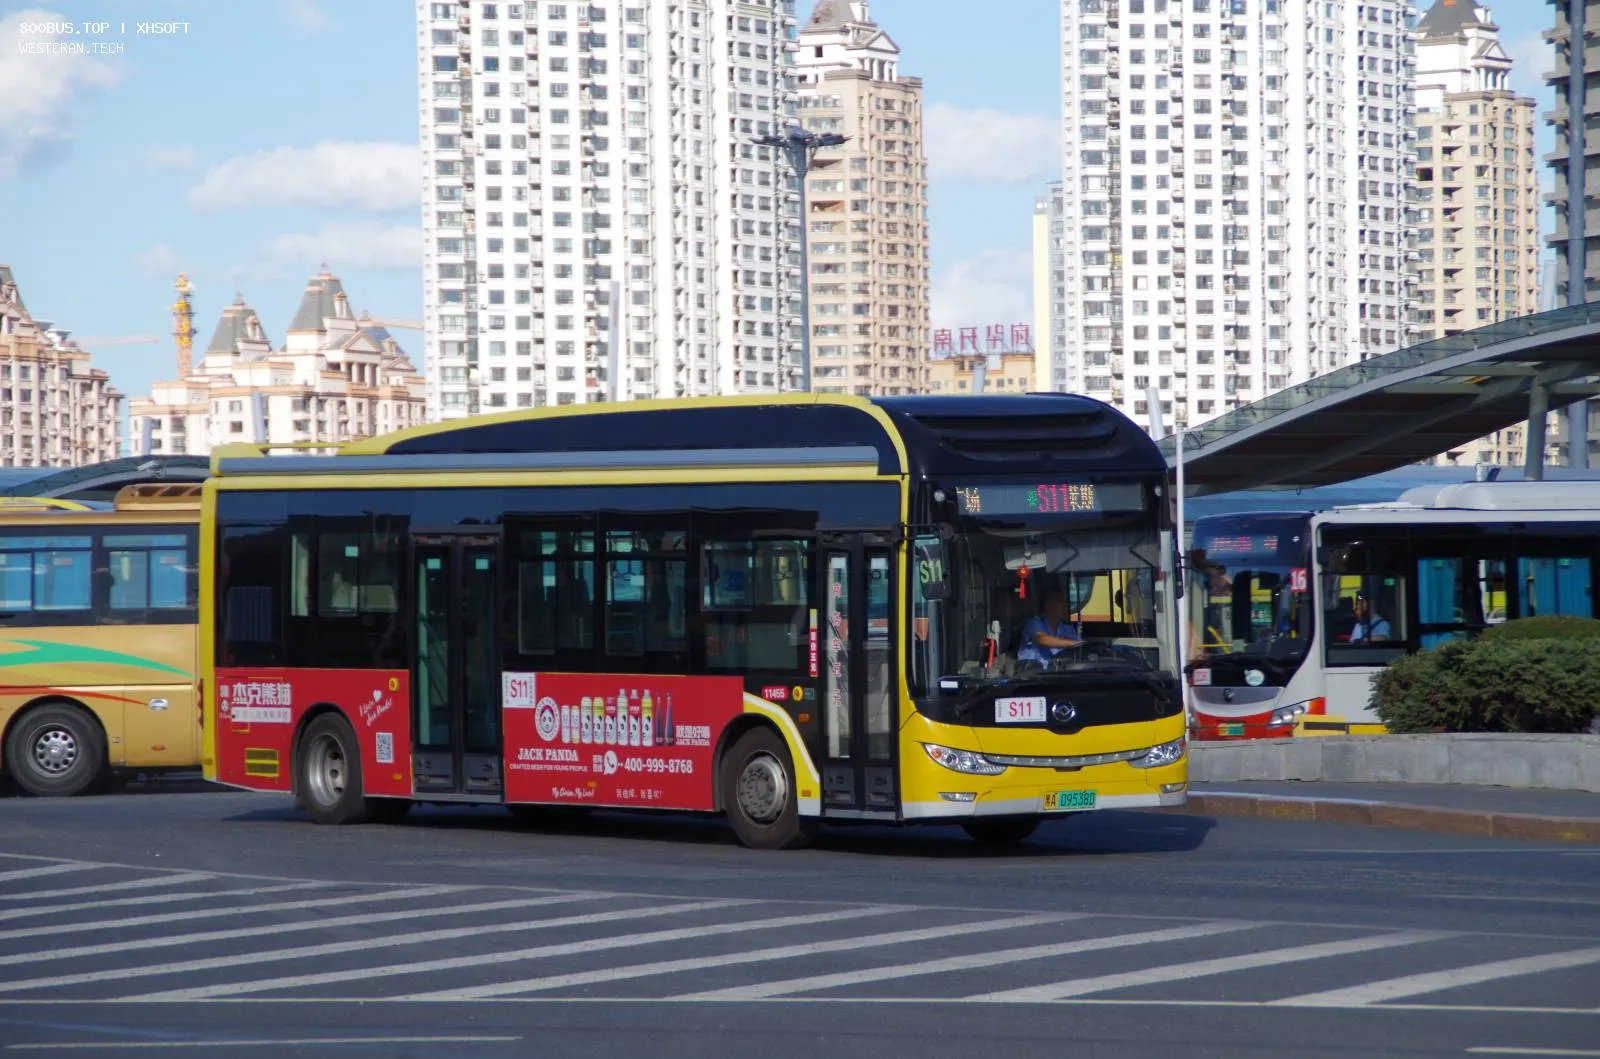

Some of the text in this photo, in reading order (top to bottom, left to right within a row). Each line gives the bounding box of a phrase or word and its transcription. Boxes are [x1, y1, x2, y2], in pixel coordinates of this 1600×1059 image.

[1036, 483, 1069, 513] S11
[919, 559, 943, 583] S11
[231, 682, 291, 705] 杰克熊猫
[510, 678, 528, 700] S11
[1009, 701, 1032, 717] S11
[517, 747, 543, 761] JACK
[545, 748, 579, 762] PANDA
[624, 757, 693, 774] 400-999-8768
